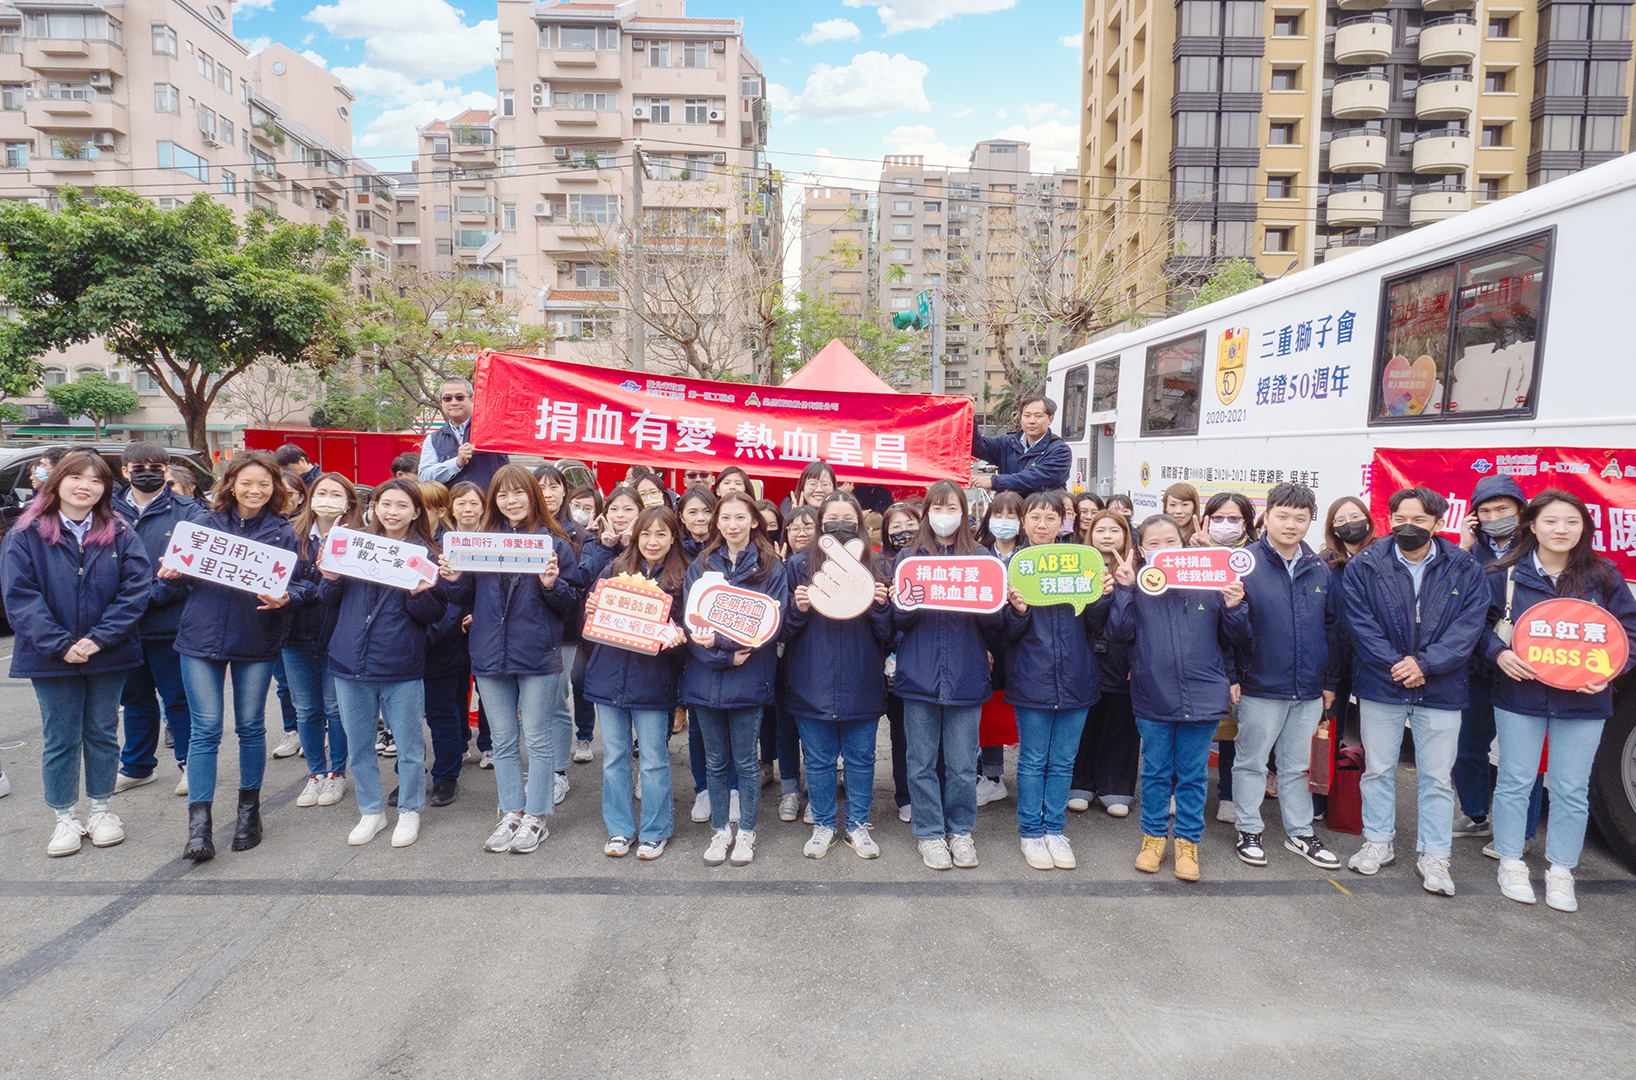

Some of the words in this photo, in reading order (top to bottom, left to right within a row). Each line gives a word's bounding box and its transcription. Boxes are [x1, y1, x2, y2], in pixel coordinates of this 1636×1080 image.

[1260, 310, 1357, 358] 三重獅子會
[1256, 365, 1350, 405] 授證50週年
[1206, 408, 1247, 424] 2020-2021
[535, 398, 717, 456] 捐血有愛
[735, 421, 908, 471] 熱血皇昌
[190, 530, 270, 564] 皇昌用心
[351, 536, 401, 556] 捐血一袋
[451, 536, 545, 550] 熱血同行，傳愛捷運
[357, 549, 405, 569] 救人一家
[1162, 556, 1212, 568] 士林捐血
[199, 557, 278, 590] 里民安心
[916, 565, 980, 583] 捐血有愛
[1176, 569, 1227, 582] 從我做起
[930, 586, 993, 602] 熱血皇昌
[1040, 576, 1093, 595] 我驕傲
[605, 593, 659, 615] 掌聲鼓勵
[714, 595, 765, 619] 定期捐血
[599, 612, 669, 640] 熱心捐血人
[710, 607, 761, 637] 捐好捐滿
[1529, 619, 1607, 644] 血紅素
